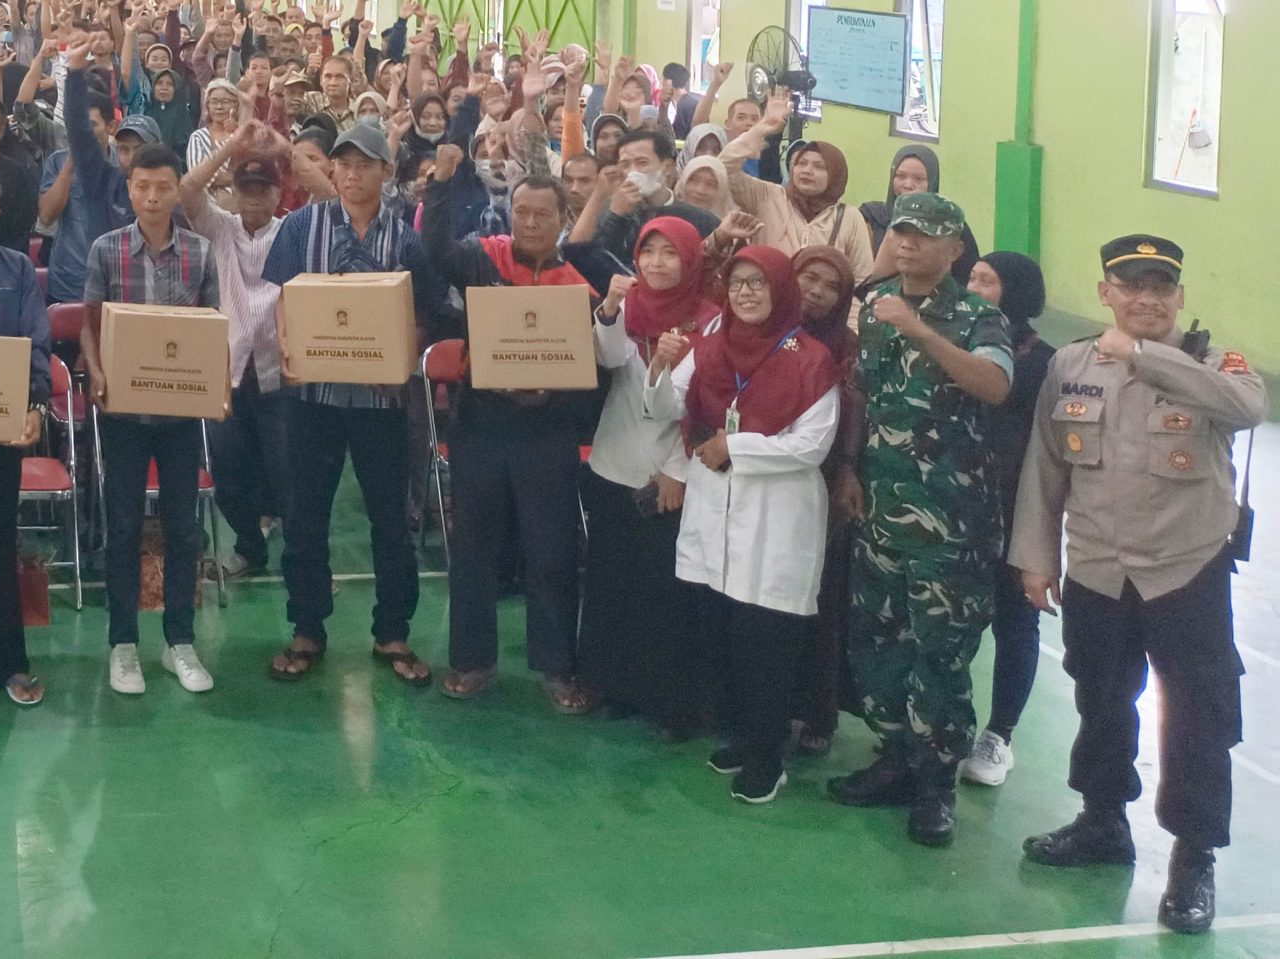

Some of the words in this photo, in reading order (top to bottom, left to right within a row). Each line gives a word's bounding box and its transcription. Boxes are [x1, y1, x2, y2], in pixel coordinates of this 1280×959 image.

[306, 349, 349, 358] BANTUAN
[351, 350, 384, 359] SOSIAL
[492, 353, 538, 361] BANTUAN
[540, 353, 576, 361] SOSIAL
[130, 379, 174, 390] BANTUAN
[176, 383, 208, 392] SOSIAL
